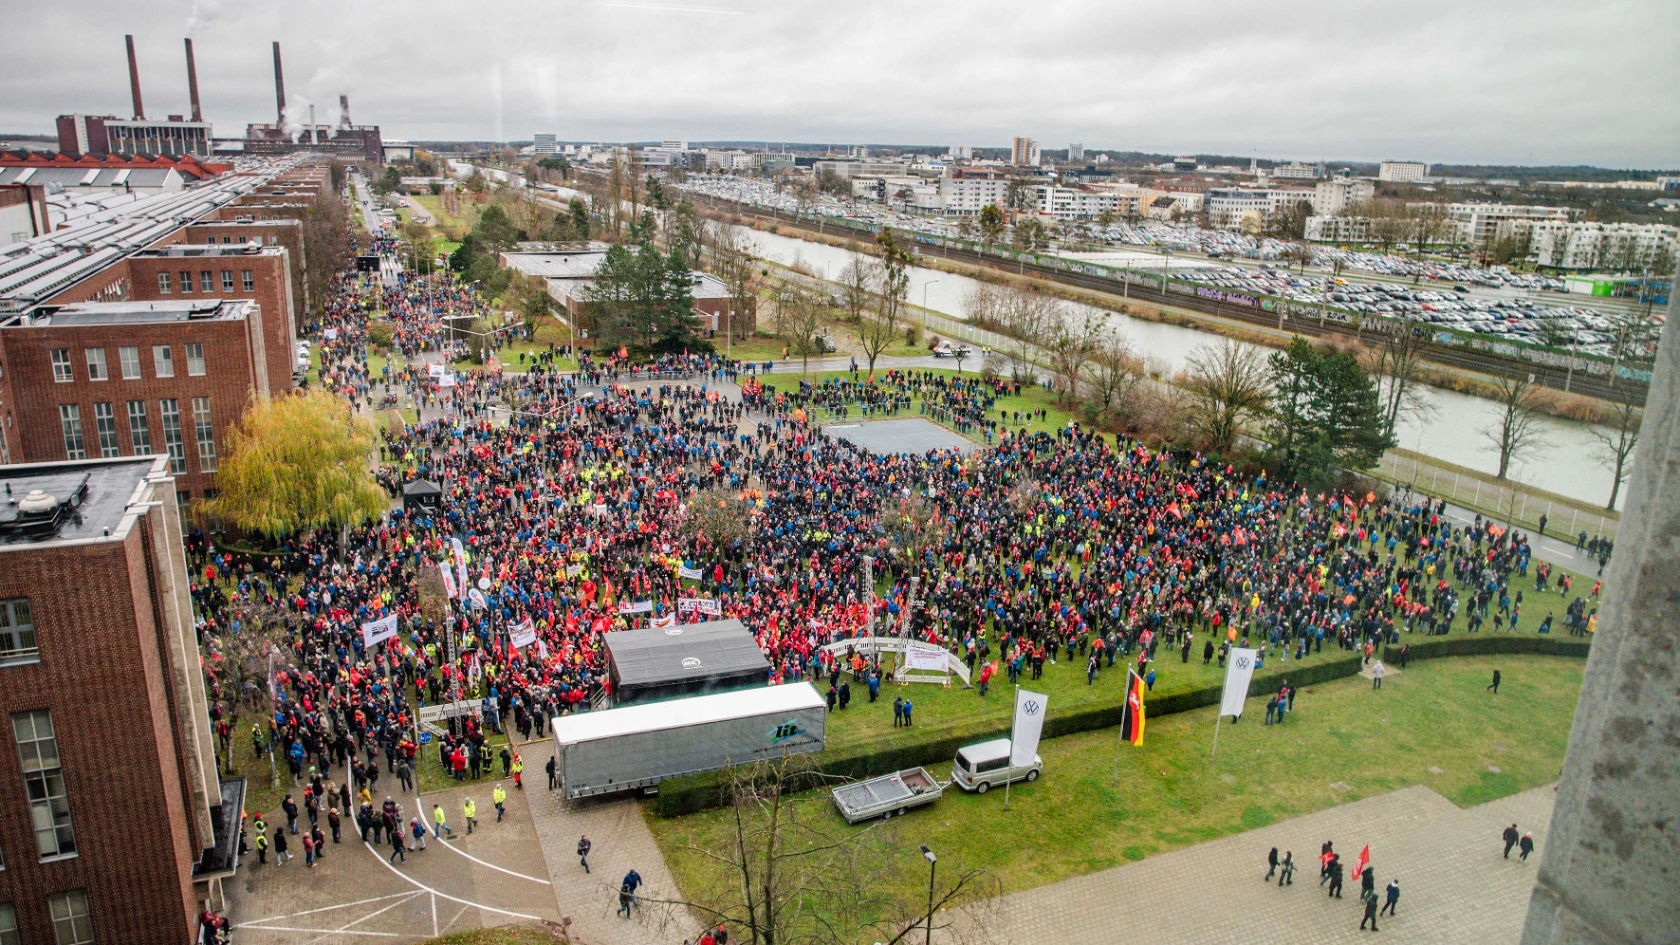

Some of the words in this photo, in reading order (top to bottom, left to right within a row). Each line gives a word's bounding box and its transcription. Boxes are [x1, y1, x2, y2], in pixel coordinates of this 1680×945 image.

[1235, 657, 1250, 670] VW
[1023, 700, 1039, 716] VW
[776, 724, 798, 738] lit
